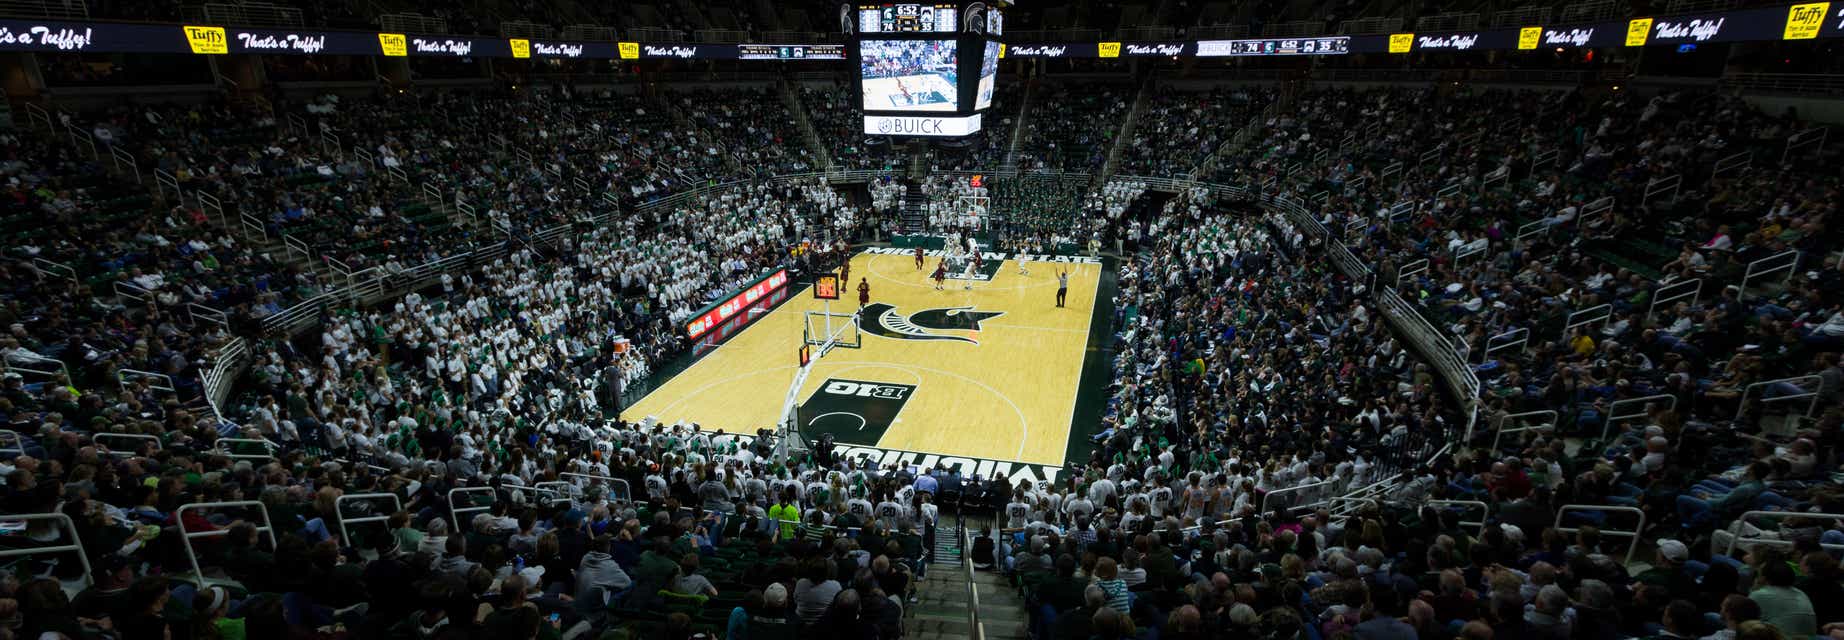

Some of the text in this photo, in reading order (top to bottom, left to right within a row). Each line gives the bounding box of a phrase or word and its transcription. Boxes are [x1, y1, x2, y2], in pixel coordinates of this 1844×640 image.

[897, 6, 917, 15] 6:52
[1791, 6, 1823, 24] Tuffy
[882, 22, 894, 31] 74
[921, 22, 932, 31] 35
[1656, 22, 1682, 39] That's
[1689, 17, 1725, 41] Tuffy!
[18, 32, 32, 43] a
[31, 26, 91, 50] Tuffy!
[187, 28, 223, 42] Tuffy
[381, 35, 403, 46] Tuffy
[238, 33, 278, 49] That's
[287, 34, 325, 53] Tuffy!
[413, 39, 440, 52] That's
[445, 40, 471, 55] Tuffy!
[1247, 43, 1258, 52] 74
[1419, 36, 1444, 48] That's
[1449, 34, 1478, 50] Tuffy!
[534, 43, 556, 54] That's
[560, 44, 582, 57] Tuffy!
[644, 46, 667, 56] That's
[671, 46, 696, 58] Tuffy!
[1011, 46, 1034, 56] That's
[1039, 46, 1066, 57] Tuffy!
[1126, 44, 1150, 54] That's
[1155, 44, 1184, 56] Tuffy!
[894, 119, 943, 134] BUICK
[852, 502, 864, 513] 20
[882, 506, 896, 517] 20
[1012, 506, 1026, 517] 20
